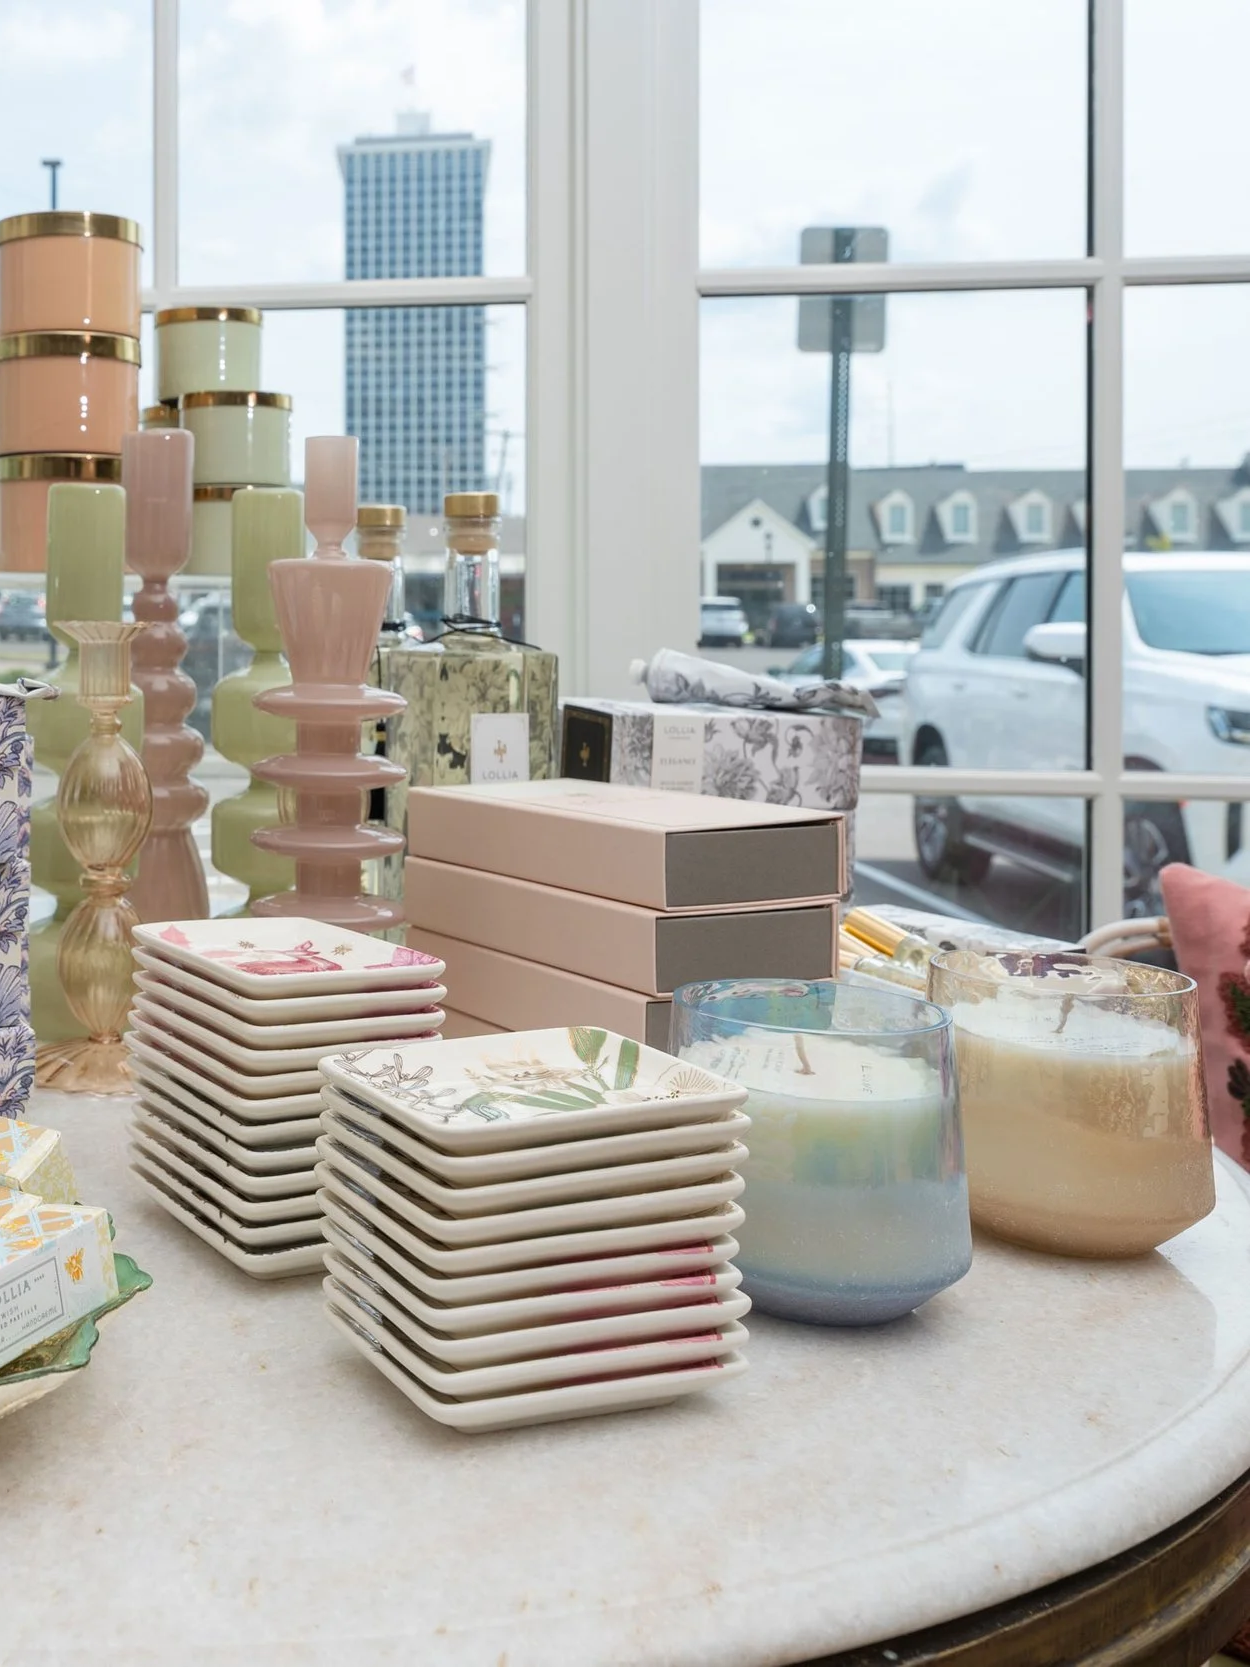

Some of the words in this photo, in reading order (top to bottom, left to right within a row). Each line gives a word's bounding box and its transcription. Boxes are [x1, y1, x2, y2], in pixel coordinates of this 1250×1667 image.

[663, 725, 695, 735] LOLLIA
[482, 770, 519, 781] LOLLIA
[1, 1306, 19, 1319] WISH
